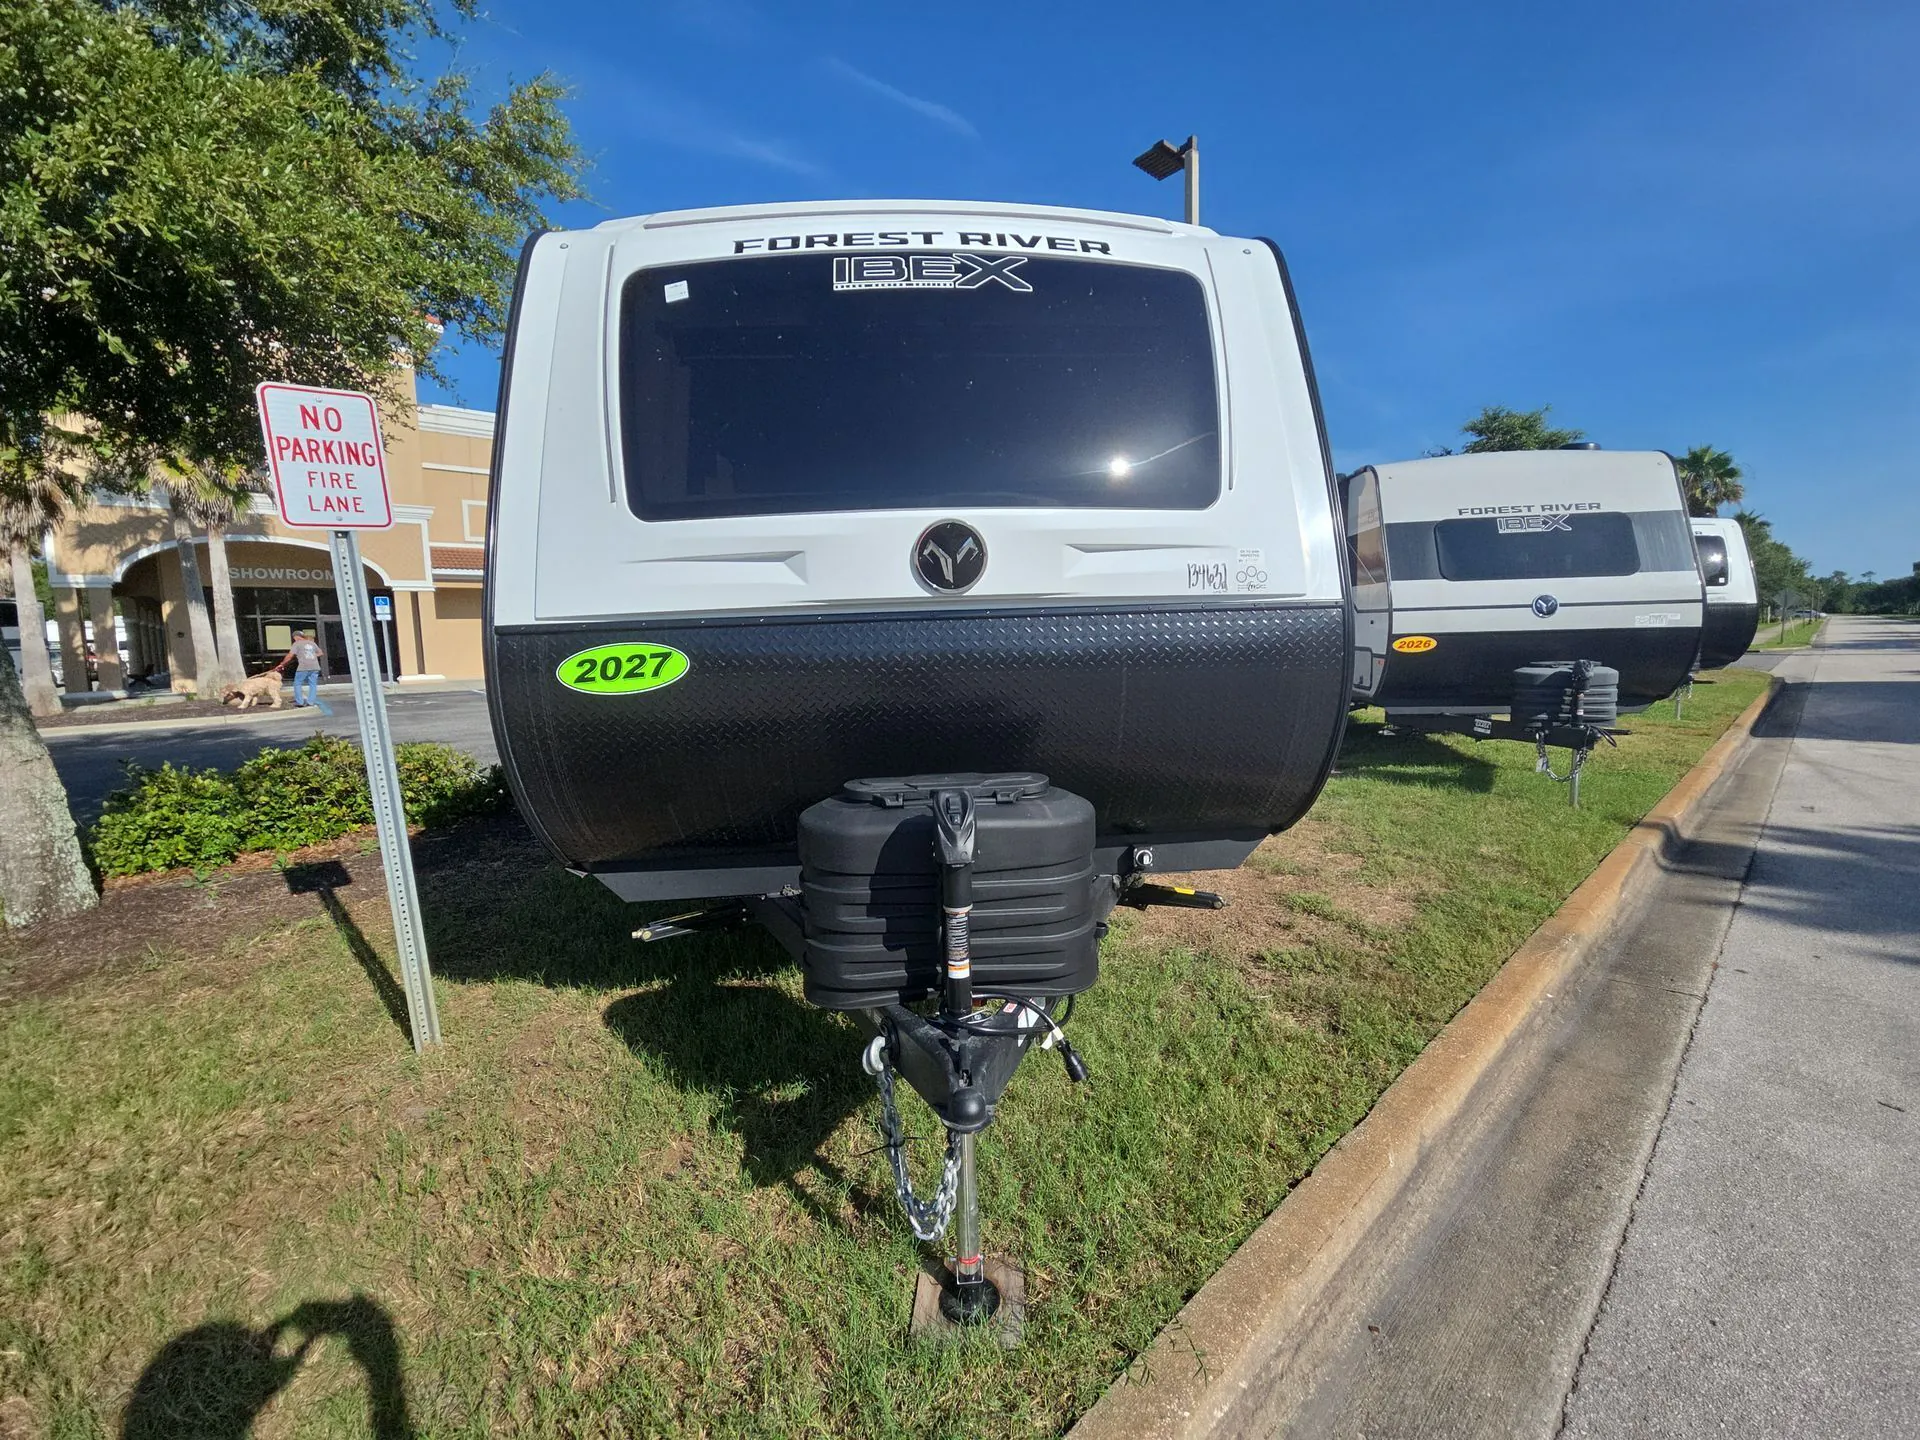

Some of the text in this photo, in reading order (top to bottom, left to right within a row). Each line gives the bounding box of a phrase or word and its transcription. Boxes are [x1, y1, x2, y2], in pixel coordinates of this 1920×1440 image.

[733, 231, 1113, 255] FOREST RIVER
[833, 253, 1033, 292] IBEX
[299, 404, 342, 432] NO
[276, 436, 376, 467] PARKING
[307, 471, 358, 490] FIRE
[308, 495, 365, 513] LANE
[1457, 502, 1602, 516] FOREST RIVER
[1497, 513, 1573, 534] IBEX
[1397, 639, 1432, 649] 2026
[573, 651, 673, 684] 2027
